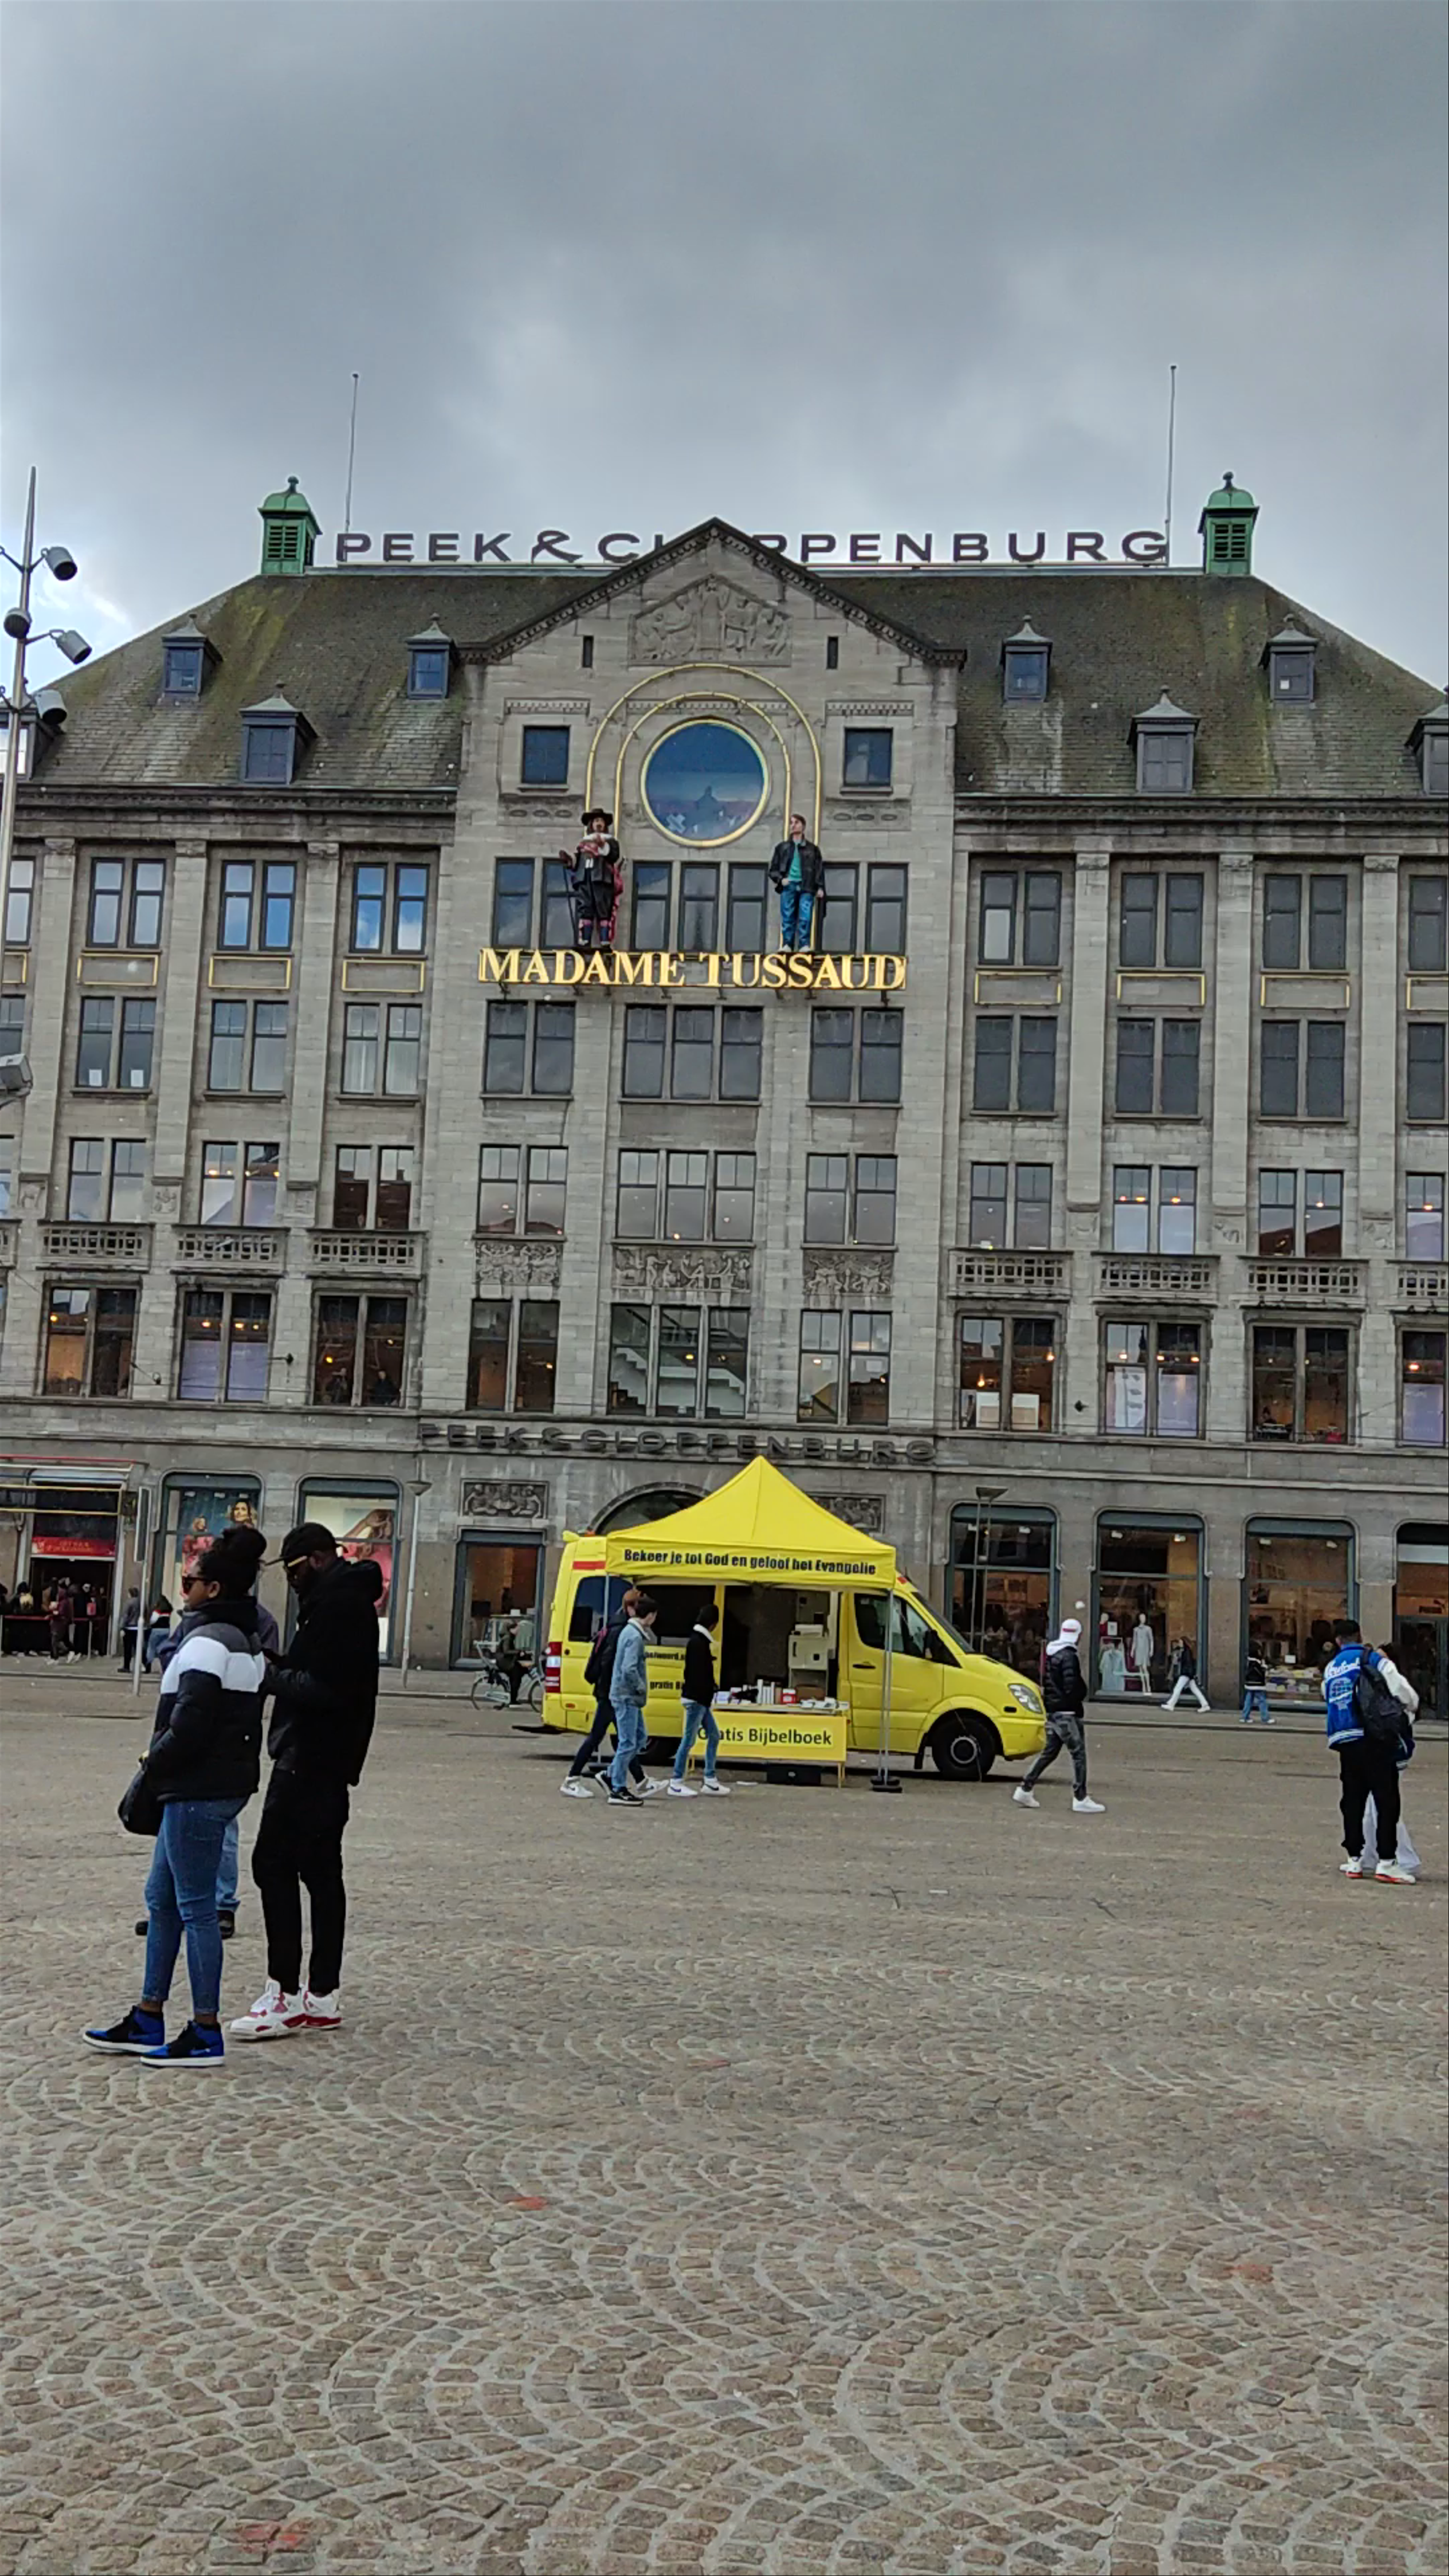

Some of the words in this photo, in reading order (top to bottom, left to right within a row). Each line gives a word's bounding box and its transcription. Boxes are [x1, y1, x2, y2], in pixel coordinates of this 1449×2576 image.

[335, 533, 512, 563] PEEK
[478, 947, 686, 987] MADAME
[699, 952, 906, 990] TUSSAUD
[624, 1549, 668, 1562] Bekeer
[670, 1551, 682, 1564] je
[685, 1552, 702, 1564] tot
[705, 1553, 729, 1566] God
[731, 1556, 747, 1566] en
[750, 1556, 790, 1569] geloof
[792, 1558, 812, 1571] het
[815, 1559, 876, 1575] Evangelie
[749, 1728, 832, 1746] Bijbelboek
